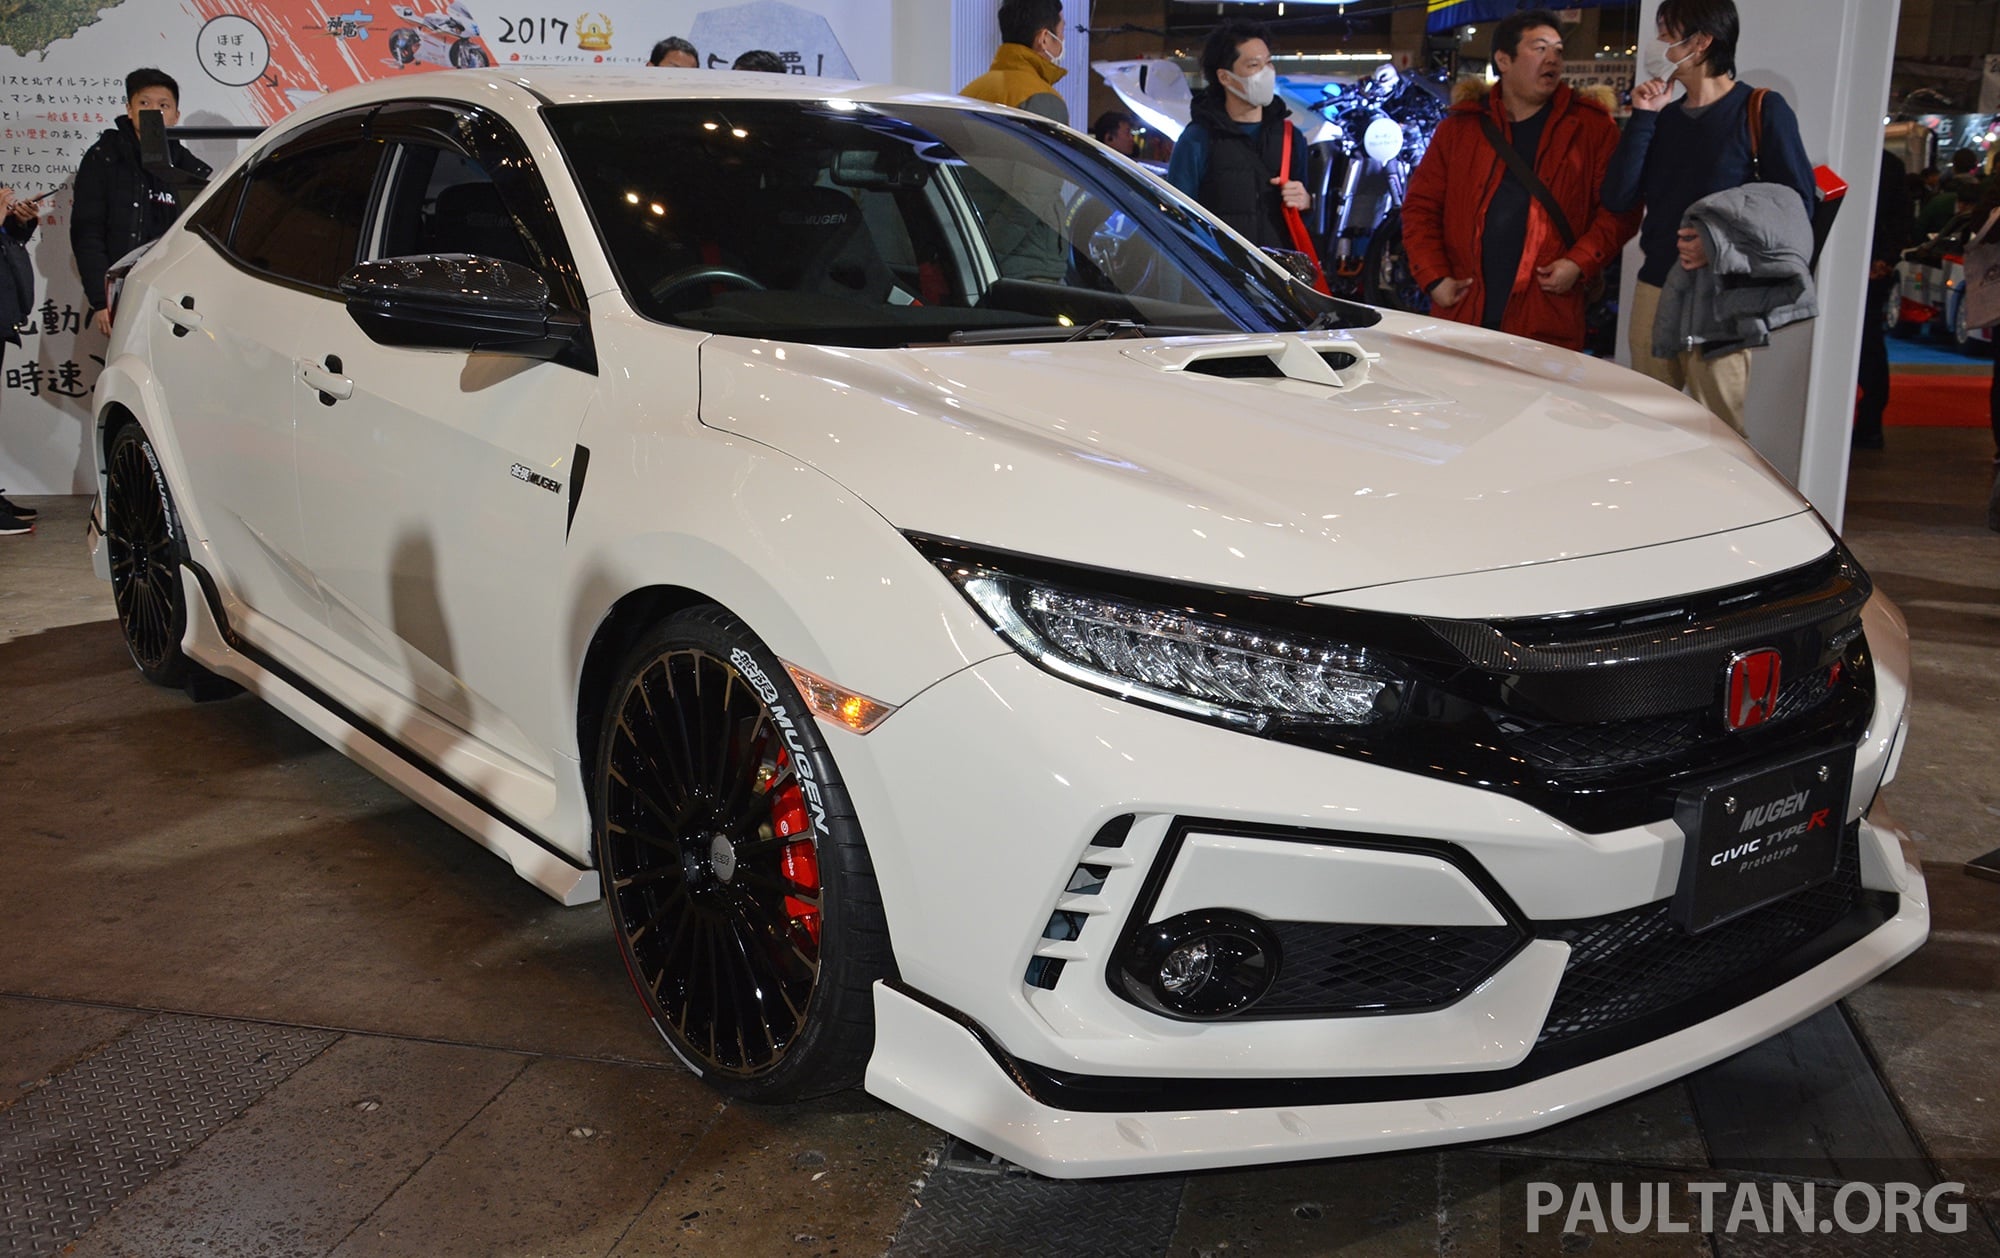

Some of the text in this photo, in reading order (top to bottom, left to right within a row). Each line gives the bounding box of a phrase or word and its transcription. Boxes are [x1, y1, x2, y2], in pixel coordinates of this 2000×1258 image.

[216, 34, 245, 47] ほぼ
[498, 16, 569, 45] 2017
[11, 164, 41, 174] ZERO
[529, 472, 562, 494] MUGEN
[770, 704, 830, 836] MUGEN
[1738, 789, 1811, 833] MUGEN
[1710, 838, 1761, 867] CIVIC
[1739, 843, 1799, 873] Prototype
